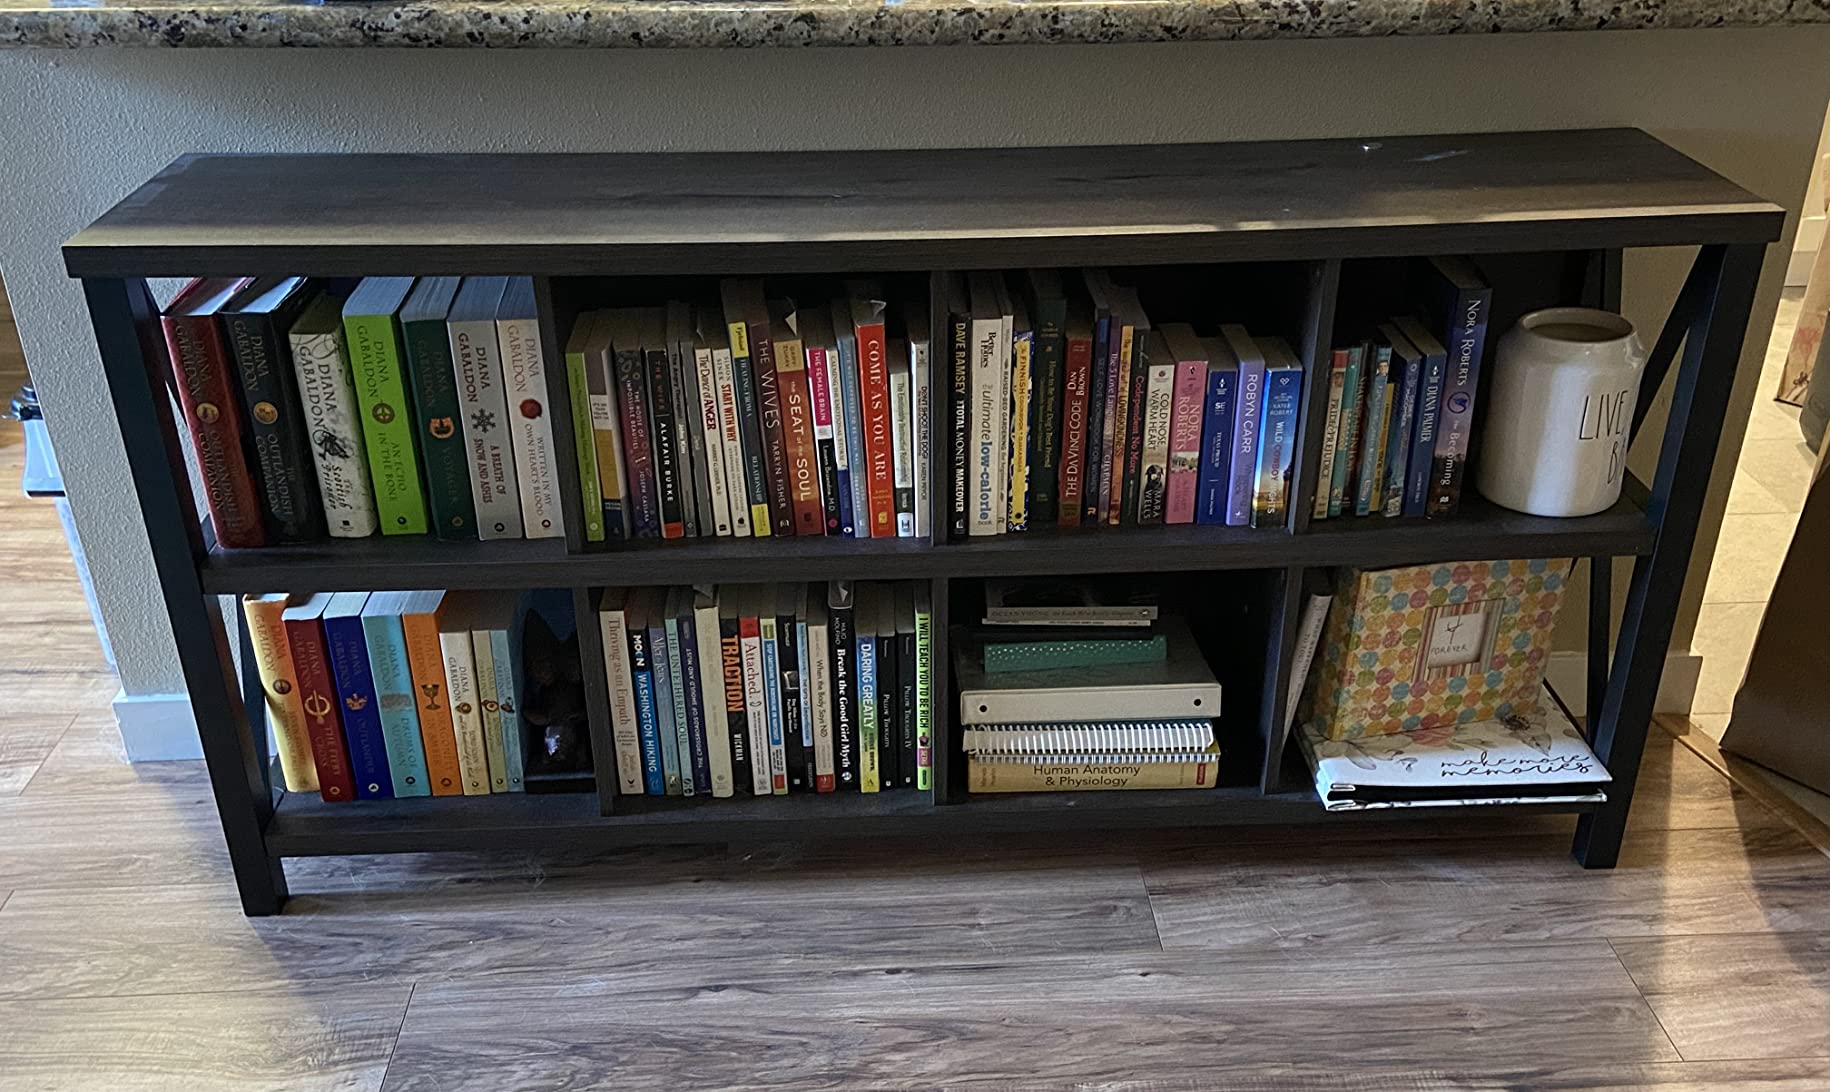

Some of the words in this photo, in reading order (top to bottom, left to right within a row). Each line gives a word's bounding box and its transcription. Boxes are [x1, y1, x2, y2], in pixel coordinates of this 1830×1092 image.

[1463, 299, 1480, 335] NORA
[955, 322, 965, 349] DAVE
[987, 332, 996, 356] Better
[173, 325, 203, 396] GABALDON
[232, 320, 259, 391] GABALDON
[249, 335, 269, 376] DIANA
[355, 325, 379, 398] GABALDON
[372, 341, 389, 383] DIANA
[507, 325, 527, 392] GABALDON
[524, 338, 539, 377] DIANA
[698, 355, 709, 368] The
[757, 338, 770, 364] THE
[813, 351, 821, 366] THE
[867, 339, 881, 384] COME
[1454, 338, 1474, 386] ROBERTS
[457, 332, 477, 402] GABALDON
[475, 346, 490, 389] DIANA
[699, 368, 711, 390] Dance
[723, 356, 731, 381] SIMON
[815, 367, 824, 397] FEMALE
[955, 351, 965, 393] RAMSEY
[1018, 355, 1026, 394] FINNISH
[1067, 372, 1076, 389] DAN
[1075, 366, 1086, 396] BROWN
[297, 346, 325, 429] GABALDON
[317, 363, 337, 411] DIANA
[625, 379, 634, 417] IMPOSSIBLE
[720, 383, 732, 406] START
[759, 369, 779, 429] WIVES
[870, 389, 882, 409] AS
[1244, 373, 1256, 417] ROBYN
[1423, 385, 1438, 411] DIANA
[703, 398, 716, 430] ANGER
[723, 407, 734, 425] WITH
[788, 393, 804, 436] SEAT
[818, 398, 826, 420] BRAIN
[955, 403, 964, 429] TOTAL
[980, 390, 994, 440] ultimate
[1069, 398, 1082, 429] CODE
[1131, 375, 1144, 433] Codependent
[1149, 389, 1160, 421] WARM
[1158, 393, 1169, 419] COLD
[1327, 398, 1338, 425] PRIDE
[725, 426, 736, 442] WHY
[872, 413, 884, 445] YOU
[1147, 421, 1158, 450] HEART
[1174, 396, 1189, 450] ROBERTS
[1186, 403, 1200, 440] NORA
[1241, 420, 1253, 453] CARR
[1273, 421, 1283, 442] WILD
[1419, 412, 1434, 442] PALMER
[473, 438, 485, 460] SNOW
[535, 436, 548, 477] WRITTEN
[660, 422, 669, 465] ALAFAIR
[771, 439, 782, 475] TARRYN
[955, 431, 964, 468] MONEY
[1131, 435, 1140, 449] No
[1320, 431, 1334, 479] PREJUDICE
[196, 432, 226, 510] COMPANION
[254, 435, 280, 512] COMPANION
[477, 462, 488, 479] AND
[491, 453, 503, 482] BREATH
[524, 423, 534, 445] OWN
[532, 486, 544, 516] BLOOD
[874, 449, 886, 480] ARE
[1129, 451, 1139, 473] More
[1270, 444, 1281, 480] COWBOY
[1440, 432, 1459, 485] Becoming
[265, 433, 293, 515] OUTLANDISH
[541, 479, 549, 490] IN
[638, 470, 646, 493] JOSEPH
[664, 470, 673, 501] BURKE
[795, 458, 811, 501] SOUL
[979, 441, 992, 520] low-calorie
[1066, 475, 1077, 496] THE
[480, 480, 492, 503] ASHES
[495, 484, 505, 495] OF
[543, 492, 552, 505] MY
[776, 478, 786, 509] FISHER
[955, 468, 963, 512] MAKEOVER
[1143, 489, 1153, 518] WELLS
[1151, 488, 1161, 517] MARA
[254, 615, 275, 671] GABALDON
[270, 624, 286, 659] DIANA
[606, 617, 623, 660] Thriving
[668, 631, 678, 651] THE
[918, 621, 927, 641] WILL
[306, 641, 320, 675] DIANA
[387, 643, 400, 678] DIANA
[633, 634, 644, 666] MOON
[836, 648, 846, 677] Break
[860, 643, 872, 682] DARING
[919, 642, 928, 667] TEACH
[448, 657, 460, 701] GABALDON
[458, 666, 469, 692] DIANA
[612, 661, 621, 673] as
[614, 675, 623, 687] an
[721, 634, 744, 713] TRACTION
[744, 642, 760, 698] Attached.
[815, 660, 823, 679] When
[919, 668, 928, 685] YOU
[670, 653, 685, 719] UNTETHERED
[816, 691, 825, 708] Body
[838, 679, 847, 694] the
[919, 686, 928, 696] TO
[614, 687, 630, 725] Empath
[816, 709, 825, 723] Says
[839, 696, 848, 721] Good
[862, 684, 873, 729] GREATLY
[919, 697, 927, 708] BE
[637, 674, 653, 736] WASHINGTON
[645, 739, 657, 772] HIKING
[677, 721, 687, 745] SOUL
[819, 725, 827, 737] NO
[840, 723, 849, 741] Girl
[919, 709, 928, 728] RICH
[733, 733, 743, 761] WICKMAN
[838, 743, 850, 767] Myth
[1441, 750, 1516, 767] make
[1519, 754, 1590, 765] more
[1033, 765, 1078, 775] Human
[1082, 764, 1141, 778] Anatomy
[1045, 776, 1056, 786] &
[1059, 776, 1129, 789] Physiology
[1441, 762, 1593, 778] memories
